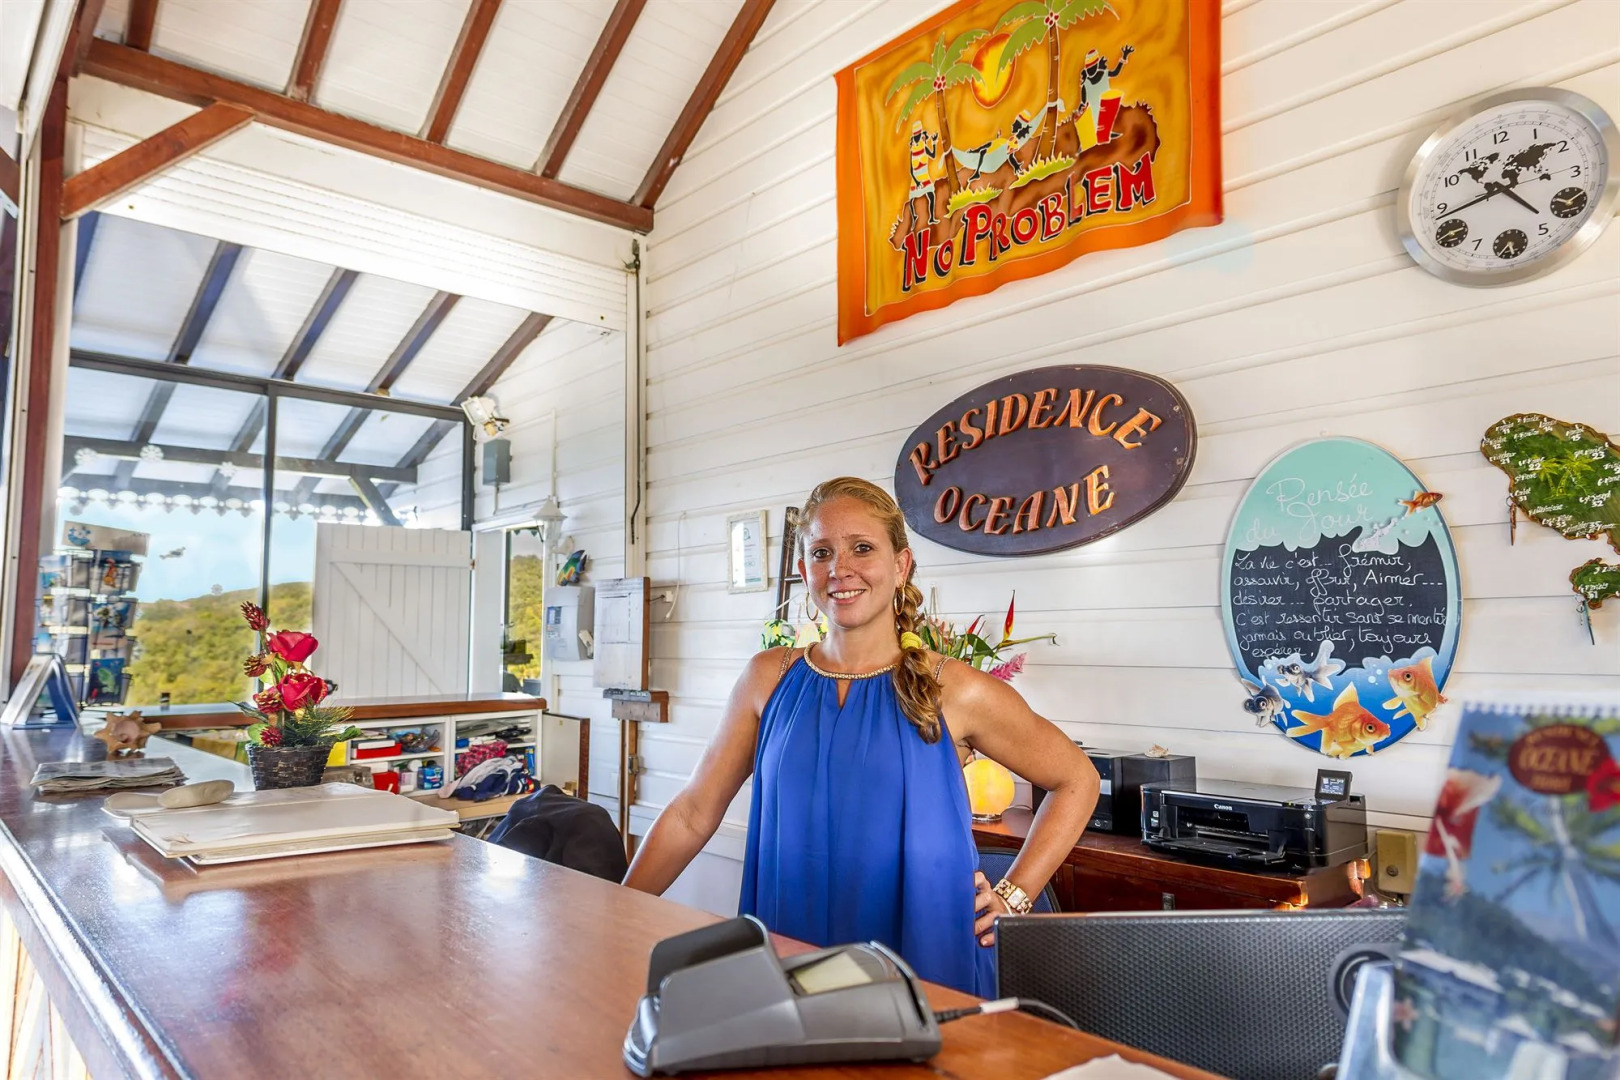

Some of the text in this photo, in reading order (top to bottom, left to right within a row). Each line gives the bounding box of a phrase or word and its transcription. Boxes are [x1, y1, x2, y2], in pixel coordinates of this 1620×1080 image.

[1494, 131, 1510, 144] 12
[1533, 129, 1537, 139] 1
[1558, 140, 1570, 153] 2
[1465, 149, 1477, 161] 11
[1570, 165, 1581, 178] 3
[1444, 174, 1459, 187] 10
[959, 152, 1157, 266] PROBLEM
[1437, 203, 1448, 214] 9
[1538, 223, 1549, 236] 5
[1472, 238, 1483, 250] 7
[909, 388, 1163, 486] RESIDENCE
[1591, 452, 1605, 460] 23
[1528, 462, 1543, 470] 22
[1266, 473, 1373, 512] Pensée
[933, 465, 1115, 535] OCEANE
[1246, 518, 1277, 543] du
[1235, 552, 1255, 570] La
[1387, 614, 1405, 624] se
[1239, 628, 1287, 651] jamais
[1359, 625, 1432, 654] toujours
[1213, 803, 1233, 811] Canon
